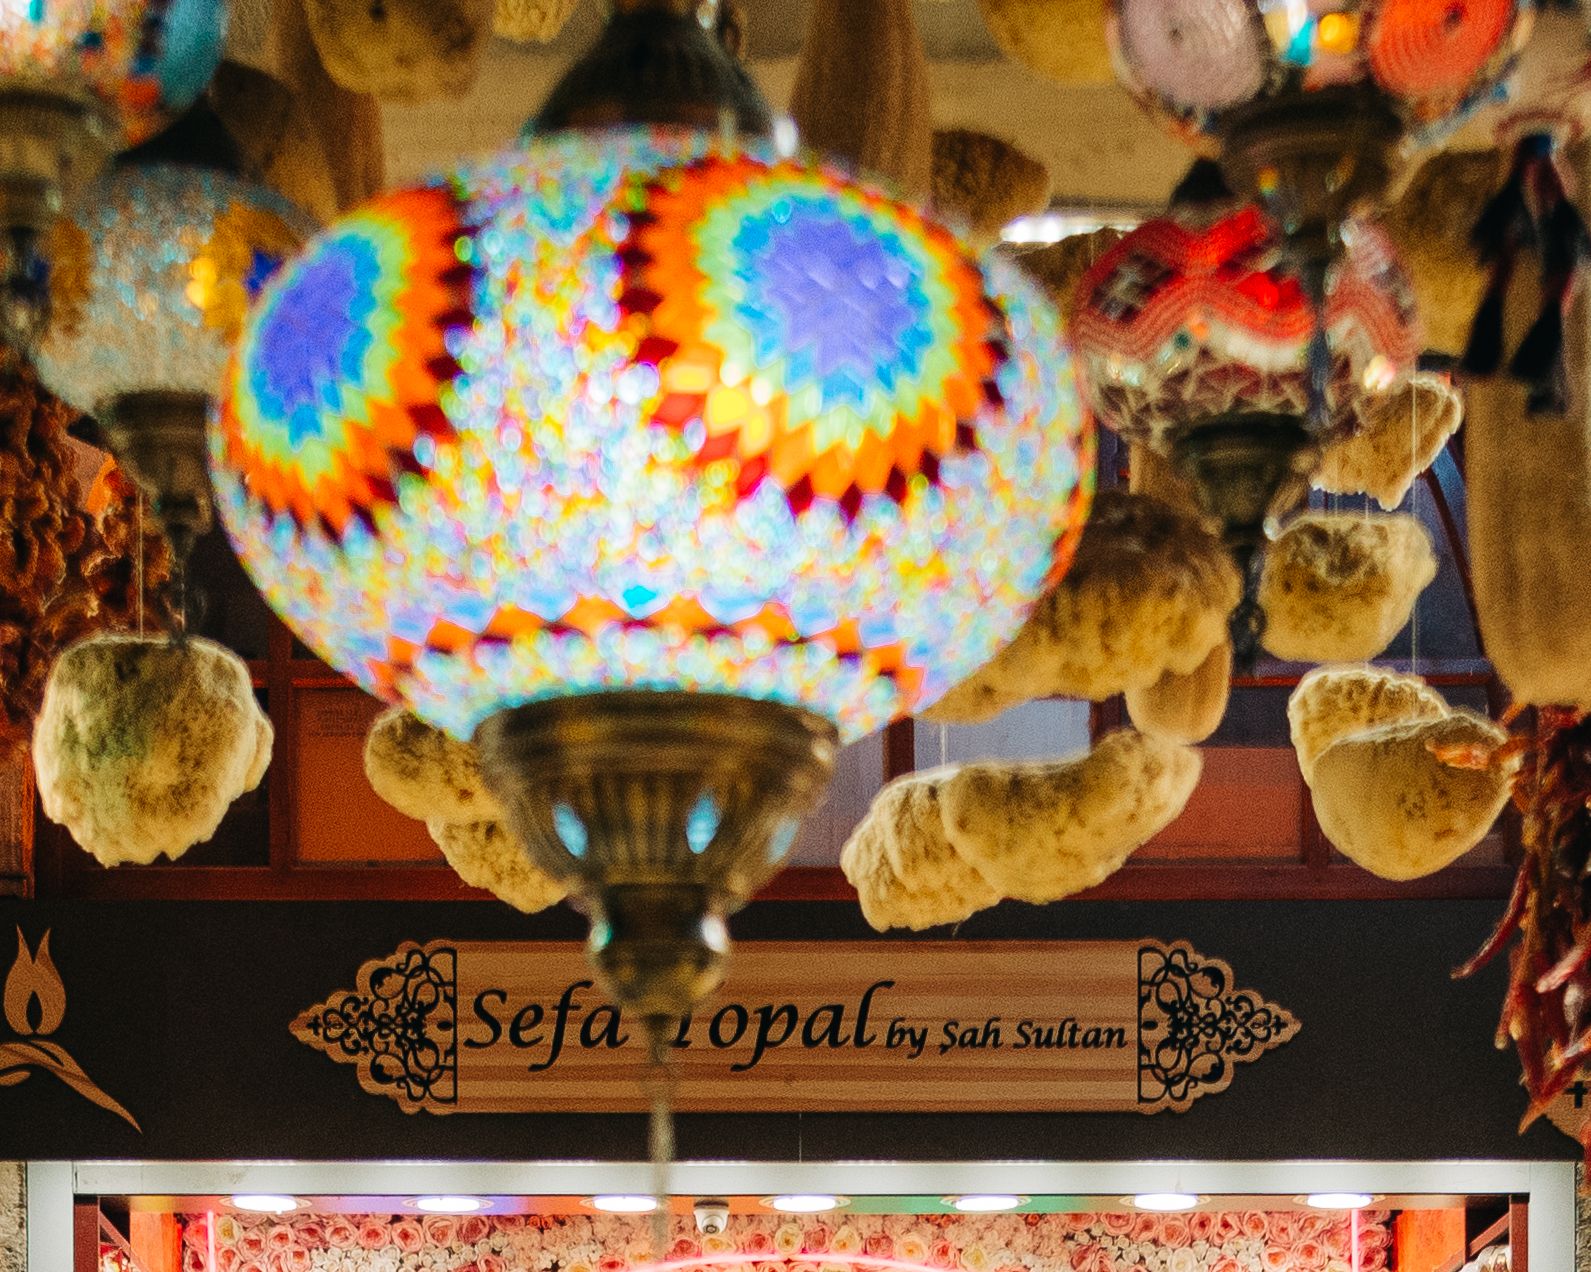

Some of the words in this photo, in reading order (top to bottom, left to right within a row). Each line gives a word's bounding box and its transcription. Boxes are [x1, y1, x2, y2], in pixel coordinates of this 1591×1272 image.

[464, 980, 629, 1072] Sefa
[886, 1020, 927, 1059] by
[937, 1017, 1002, 1059] Şah
[1011, 1018, 1128, 1051] Sultan
